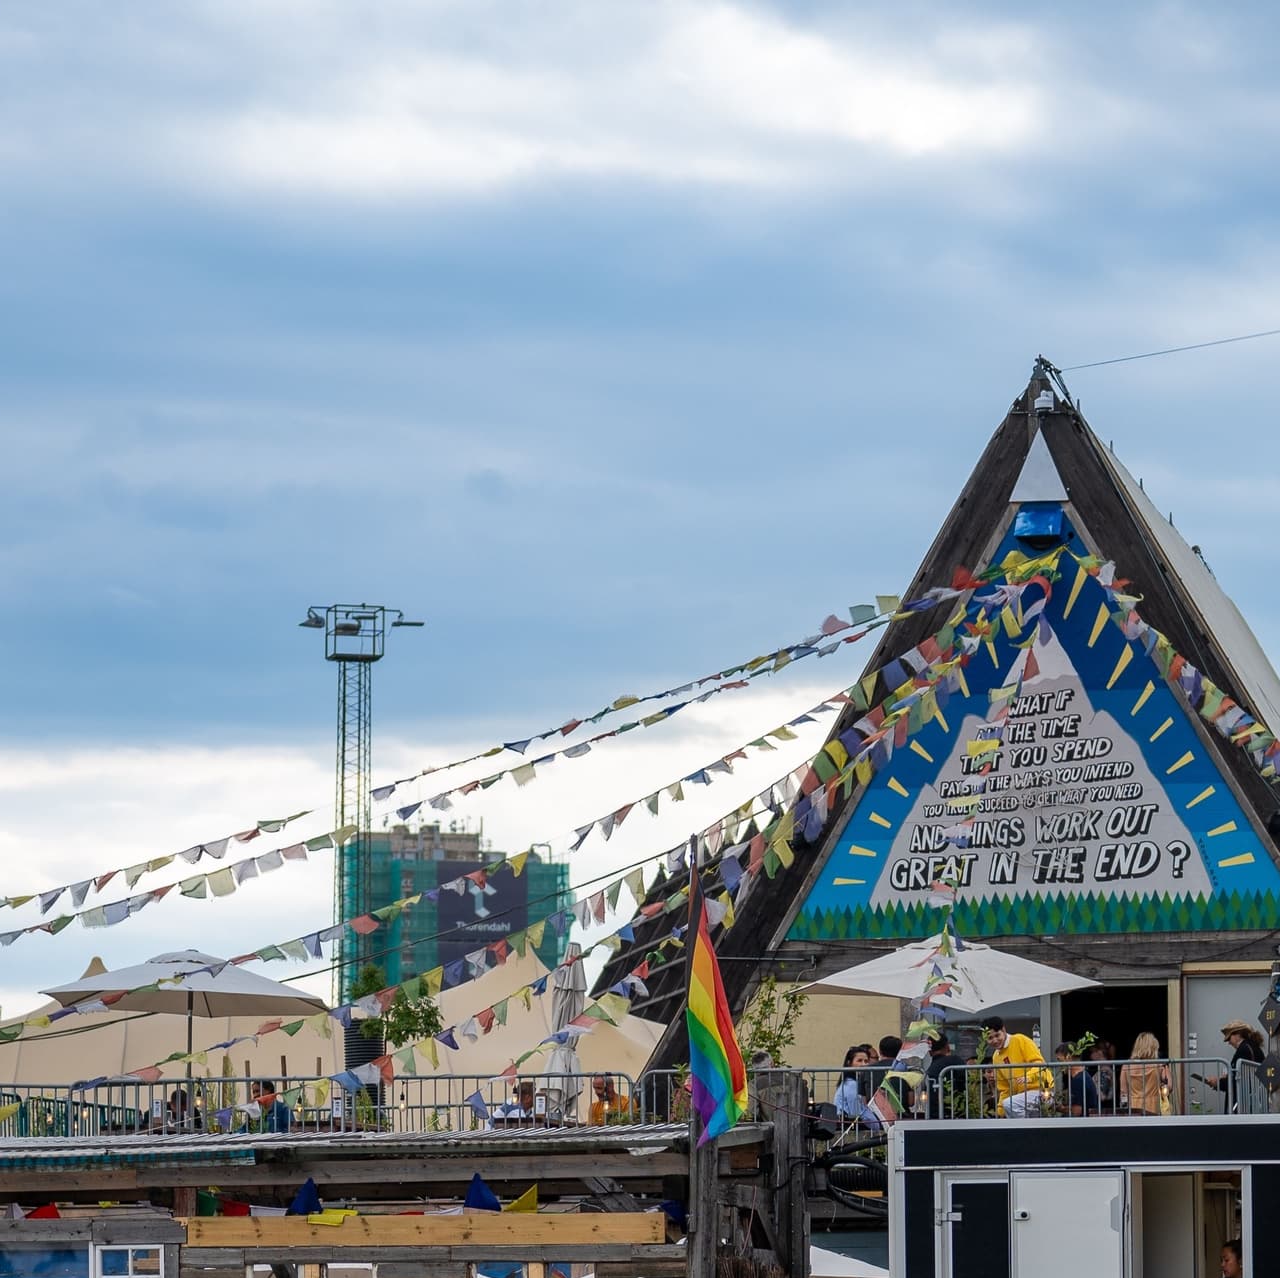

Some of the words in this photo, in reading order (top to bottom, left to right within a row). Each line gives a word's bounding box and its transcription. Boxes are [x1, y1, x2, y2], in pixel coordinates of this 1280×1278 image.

[1008, 692, 1054, 718] WHAT
[1056, 689, 1075, 711] IF
[1008, 722, 1036, 743] THE
[1041, 714, 1081, 738] TIME
[960, 752, 1003, 775] THT
[1010, 746, 1047, 768] YOU
[1051, 737, 1113, 763] SPEND
[989, 776, 1011, 792] THE
[1014, 767, 1052, 788] WAYS
[1055, 767, 1082, 784] YOU
[1083, 761, 1134, 782] INTEND
[923, 805, 943, 818] YOU
[977, 796, 1019, 812] SUCCEED
[1038, 791, 1057, 805] GET
[1059, 787, 1088, 804] WHAT
[1090, 785, 1114, 802] YOU
[1114, 783, 1143, 801] NEED
[910, 824, 950, 853] AND
[956, 817, 1026, 848] HINGS
[1035, 810, 1103, 843] WORK
[1106, 804, 1159, 838] OUT
[890, 853, 978, 891] GREAT
[989, 851, 1020, 884] IN
[1032, 847, 1086, 883] THE
[1094, 841, 1161, 882] END
[1166, 840, 1191, 878] ?
